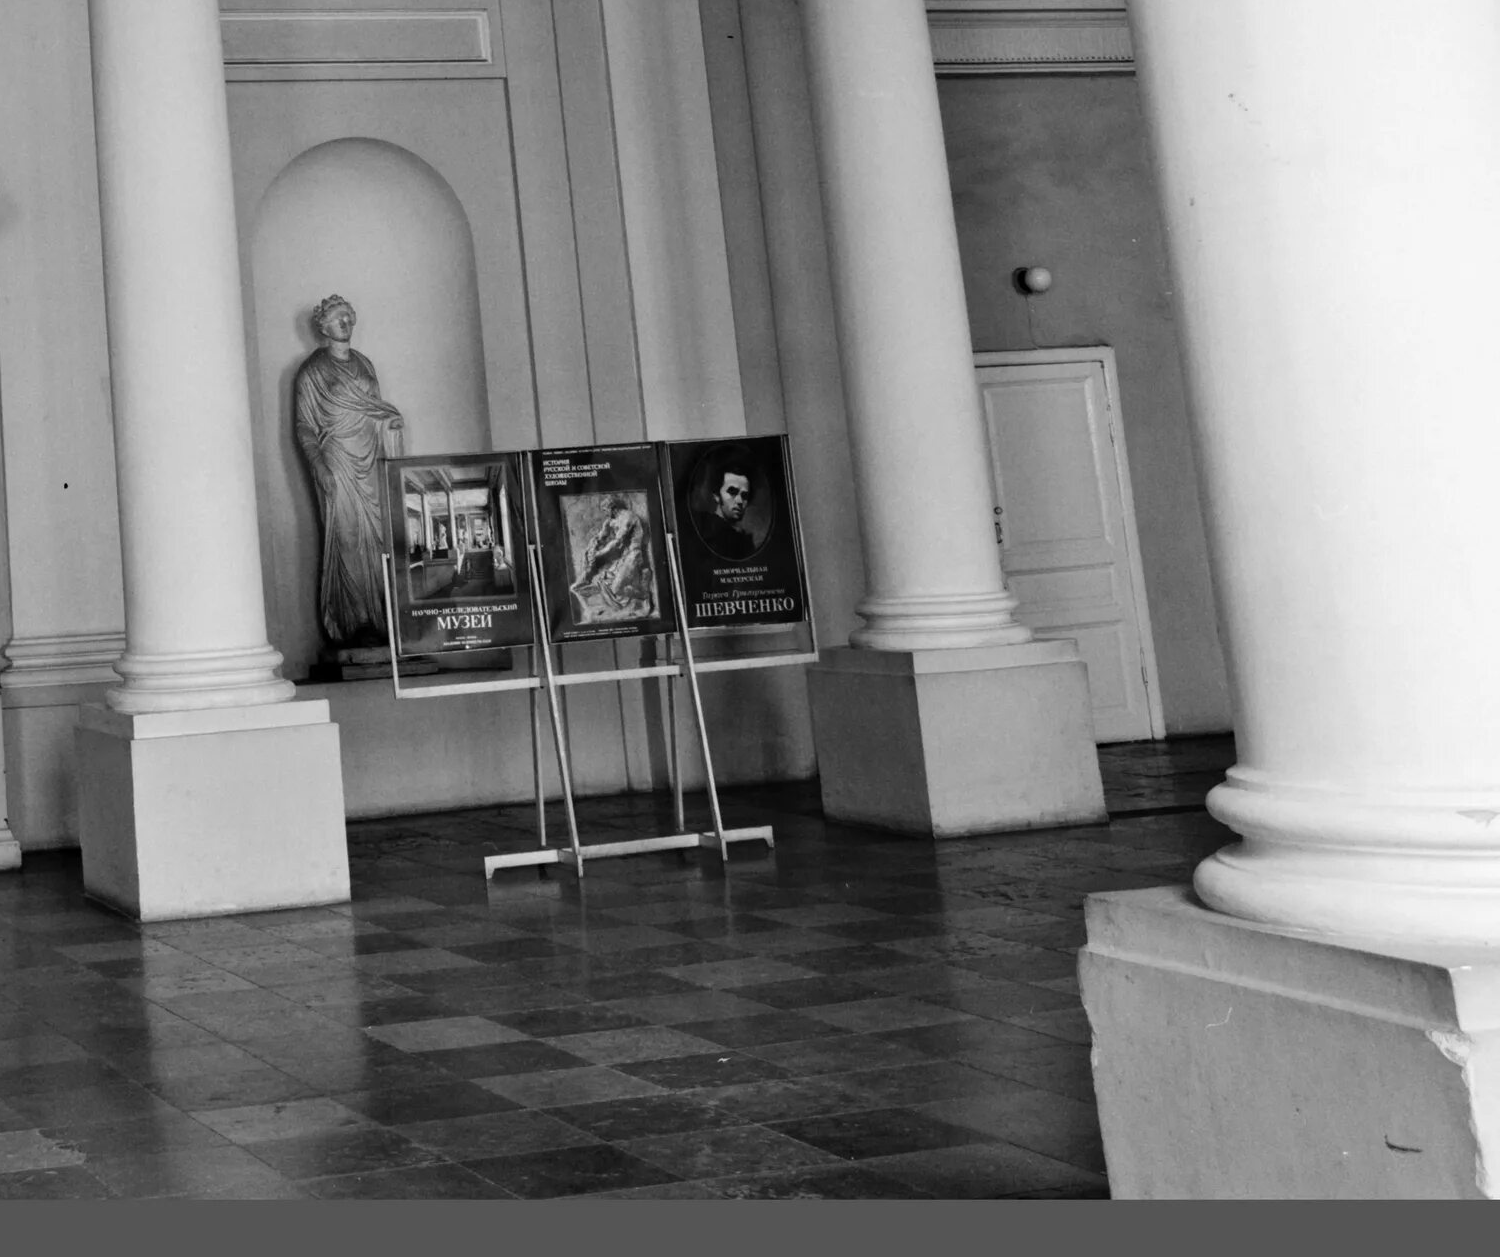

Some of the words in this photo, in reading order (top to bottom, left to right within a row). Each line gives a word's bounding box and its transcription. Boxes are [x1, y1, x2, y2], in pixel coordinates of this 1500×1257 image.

[543, 465, 571, 473] РУССКОЙ
[577, 462, 611, 471] СОВЕТСКОЙ
[544, 470, 598, 479] ХУДОЖЕСТВЕННОЙ
[713, 566, 768, 575] МЕМОРИАЛЬНАЯ
[720, 575, 764, 583] МАСТЕРСКАЯ
[412, 603, 518, 617] НАУЧНО-ИССЛЕДОВАТЕЛЬСКИЙ
[695, 596, 794, 618] ШЕВЧЕНКО
[437, 612, 492, 630] МУЗЕЙ
